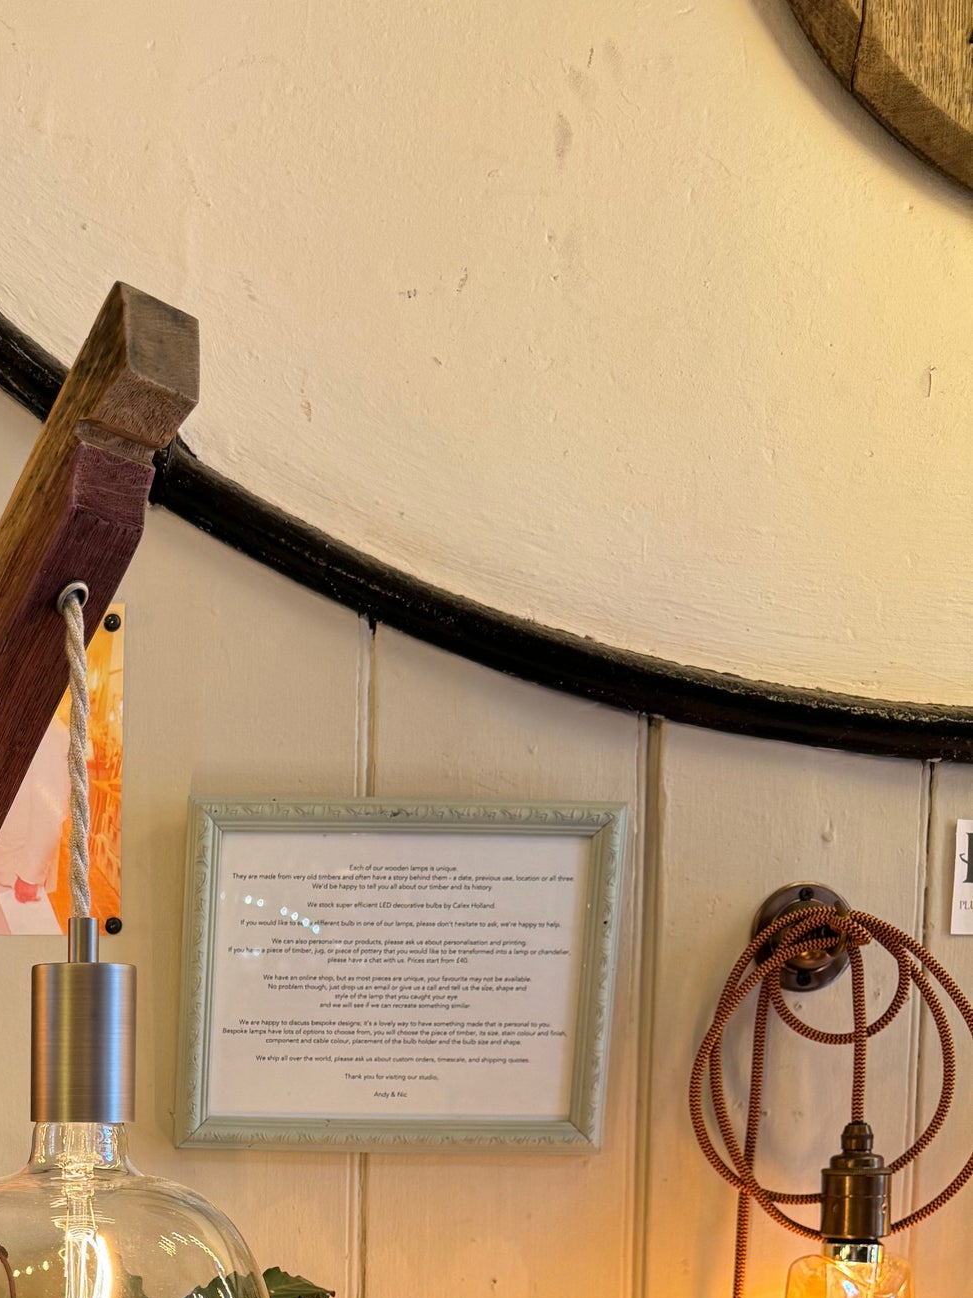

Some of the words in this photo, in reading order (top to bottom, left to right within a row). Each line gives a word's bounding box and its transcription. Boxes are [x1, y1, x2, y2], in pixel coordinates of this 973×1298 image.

[410, 864, 428, 873] lamps
[232, 872, 246, 881] They
[393, 873, 407, 882] story
[409, 873, 430, 881] behind
[431, 873, 447, 881] them
[474, 874, 500, 883] previous
[311, 882, 328, 890] We'd
[338, 883, 357, 891] happy
[452, 901, 469, 909] Calex
[295, 937, 307, 945] also
[384, 938, 403, 947] please
[443, 938, 488, 947] personalisation
[489, 938, 501, 946] and
[327, 956, 347, 965] please
[335, 992, 348, 1001] style
[357, 992, 367, 1000] the
[368, 992, 383, 1001] lamp
[410, 993, 430, 1002] caught
[418, 1002, 449, 1011] something
[385, 1073, 406, 1082] visiting
[374, 1090, 389, 1099] Andy
